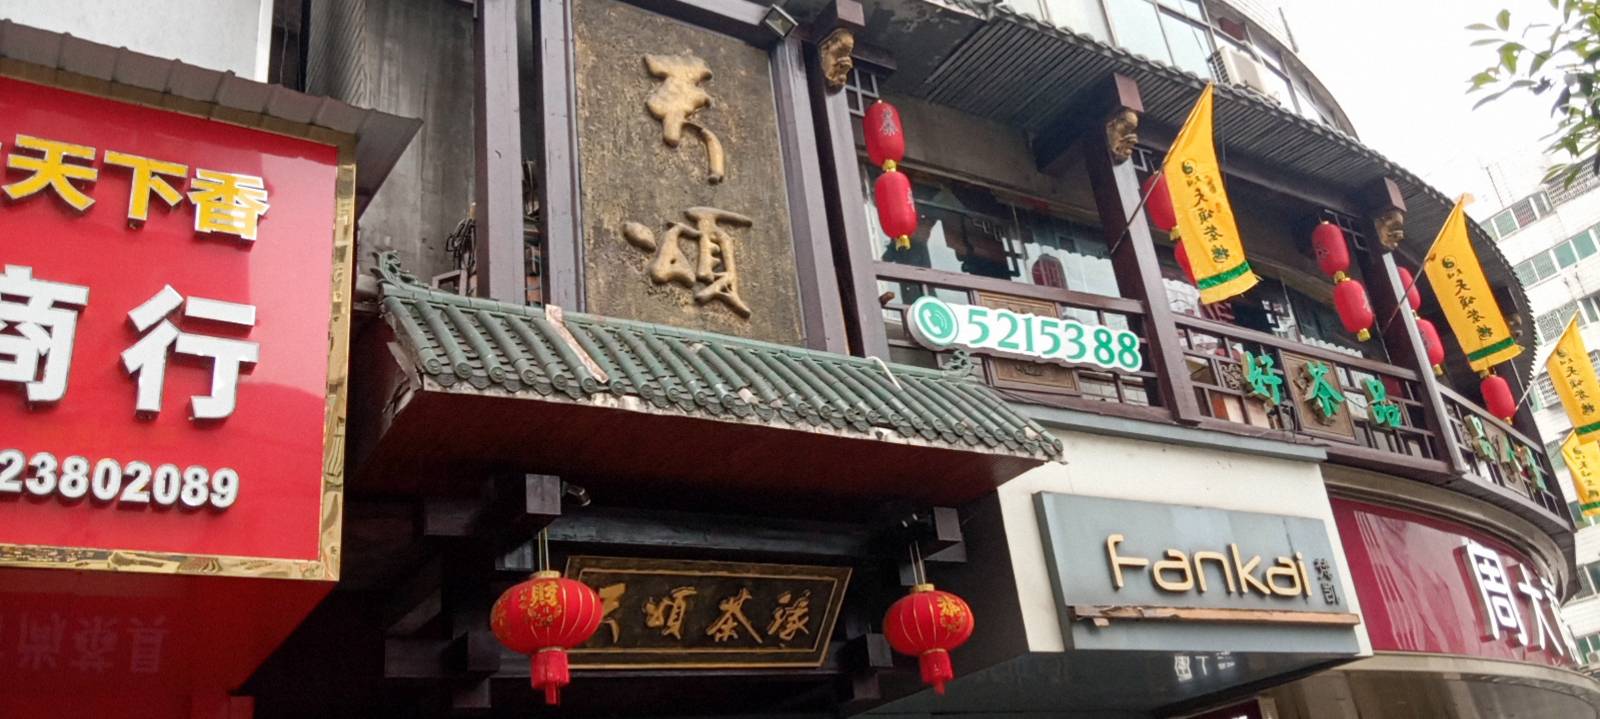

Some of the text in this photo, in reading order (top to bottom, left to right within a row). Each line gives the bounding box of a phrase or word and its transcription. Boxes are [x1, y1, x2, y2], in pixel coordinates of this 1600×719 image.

[0, 133, 269, 241] 天下香
[0, 264, 261, 421] 商行
[968, 308, 1140, 370] 5215388
[0, 448, 239, 508] 23802089
